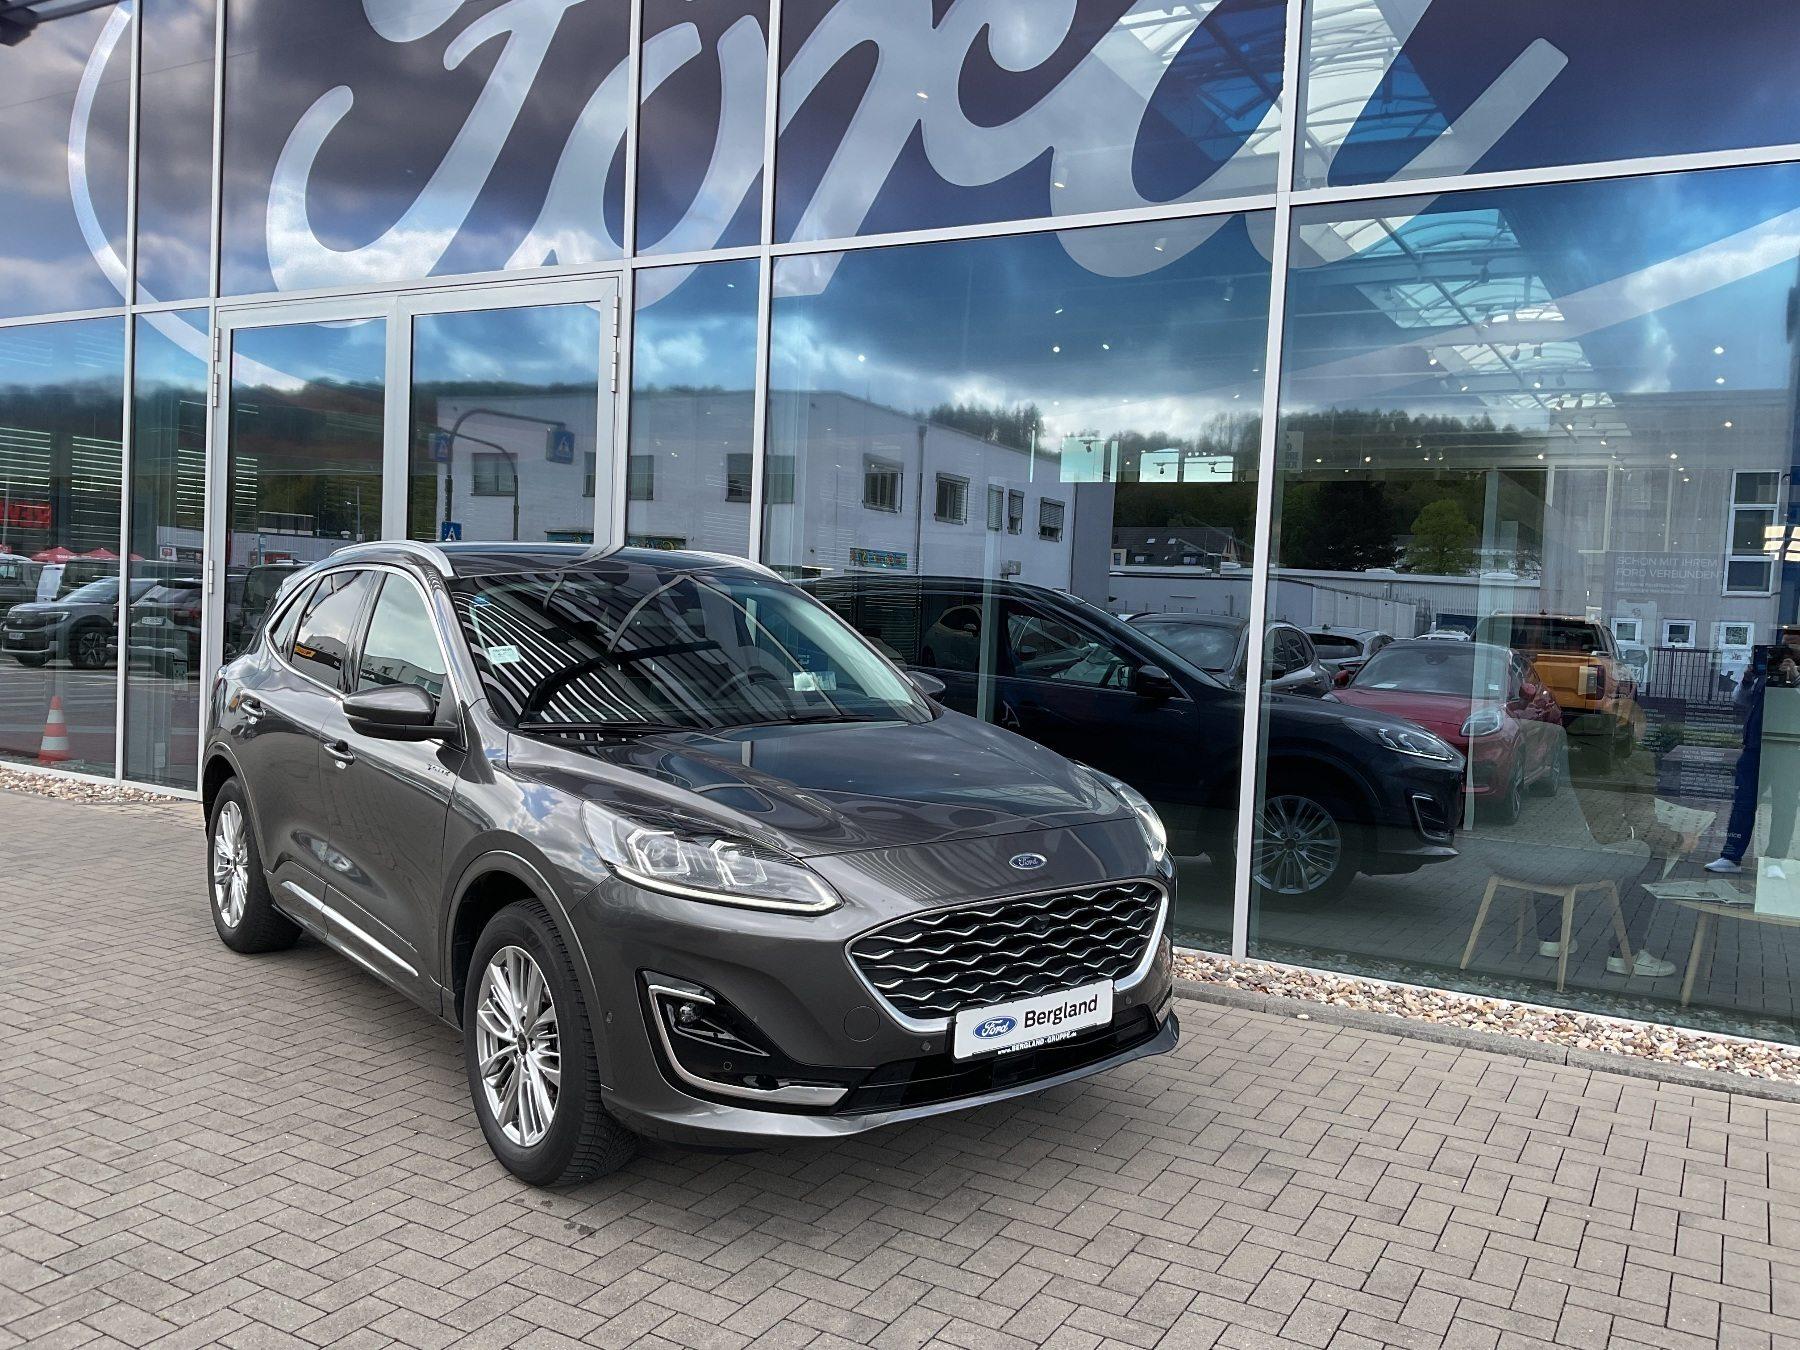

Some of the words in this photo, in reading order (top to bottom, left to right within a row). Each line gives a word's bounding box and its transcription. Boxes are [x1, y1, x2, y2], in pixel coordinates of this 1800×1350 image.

[1615, 556, 1657, 566] SCHON
[1659, 557, 1679, 567] MIT
[981, 1018, 1010, 1037] Ford
[1024, 993, 1098, 1029] Bergland
